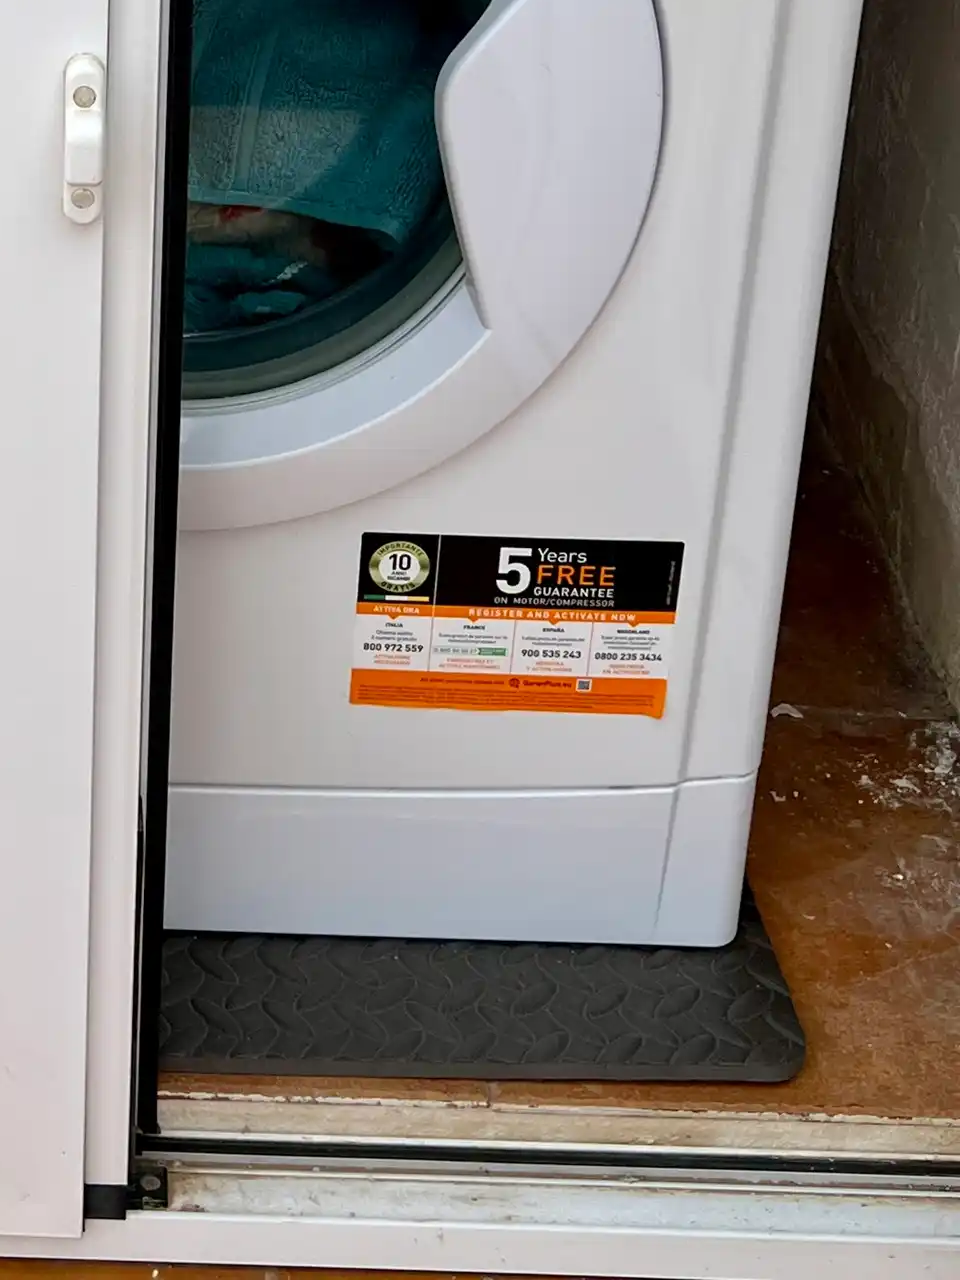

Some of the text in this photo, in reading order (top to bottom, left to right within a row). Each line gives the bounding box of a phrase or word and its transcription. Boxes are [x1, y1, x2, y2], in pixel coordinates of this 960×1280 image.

[538, 548, 588, 563] Years
[389, 553, 411, 571] 10
[496, 546, 532, 594] 5
[537, 564, 616, 586] FREE
[533, 587, 614, 598] GUARANTEE
[494, 596, 615, 607] ON MOTOR/COMPRESSOR
[468, 609, 636, 622] REGISTER AND ACTIVATE NOW
[363, 642, 382, 651] 800
[384, 643, 402, 652] 972
[405, 644, 424, 652] 559
[521, 649, 581, 658] 900 535 243
[594, 652, 662, 661] 0800 235 3434
